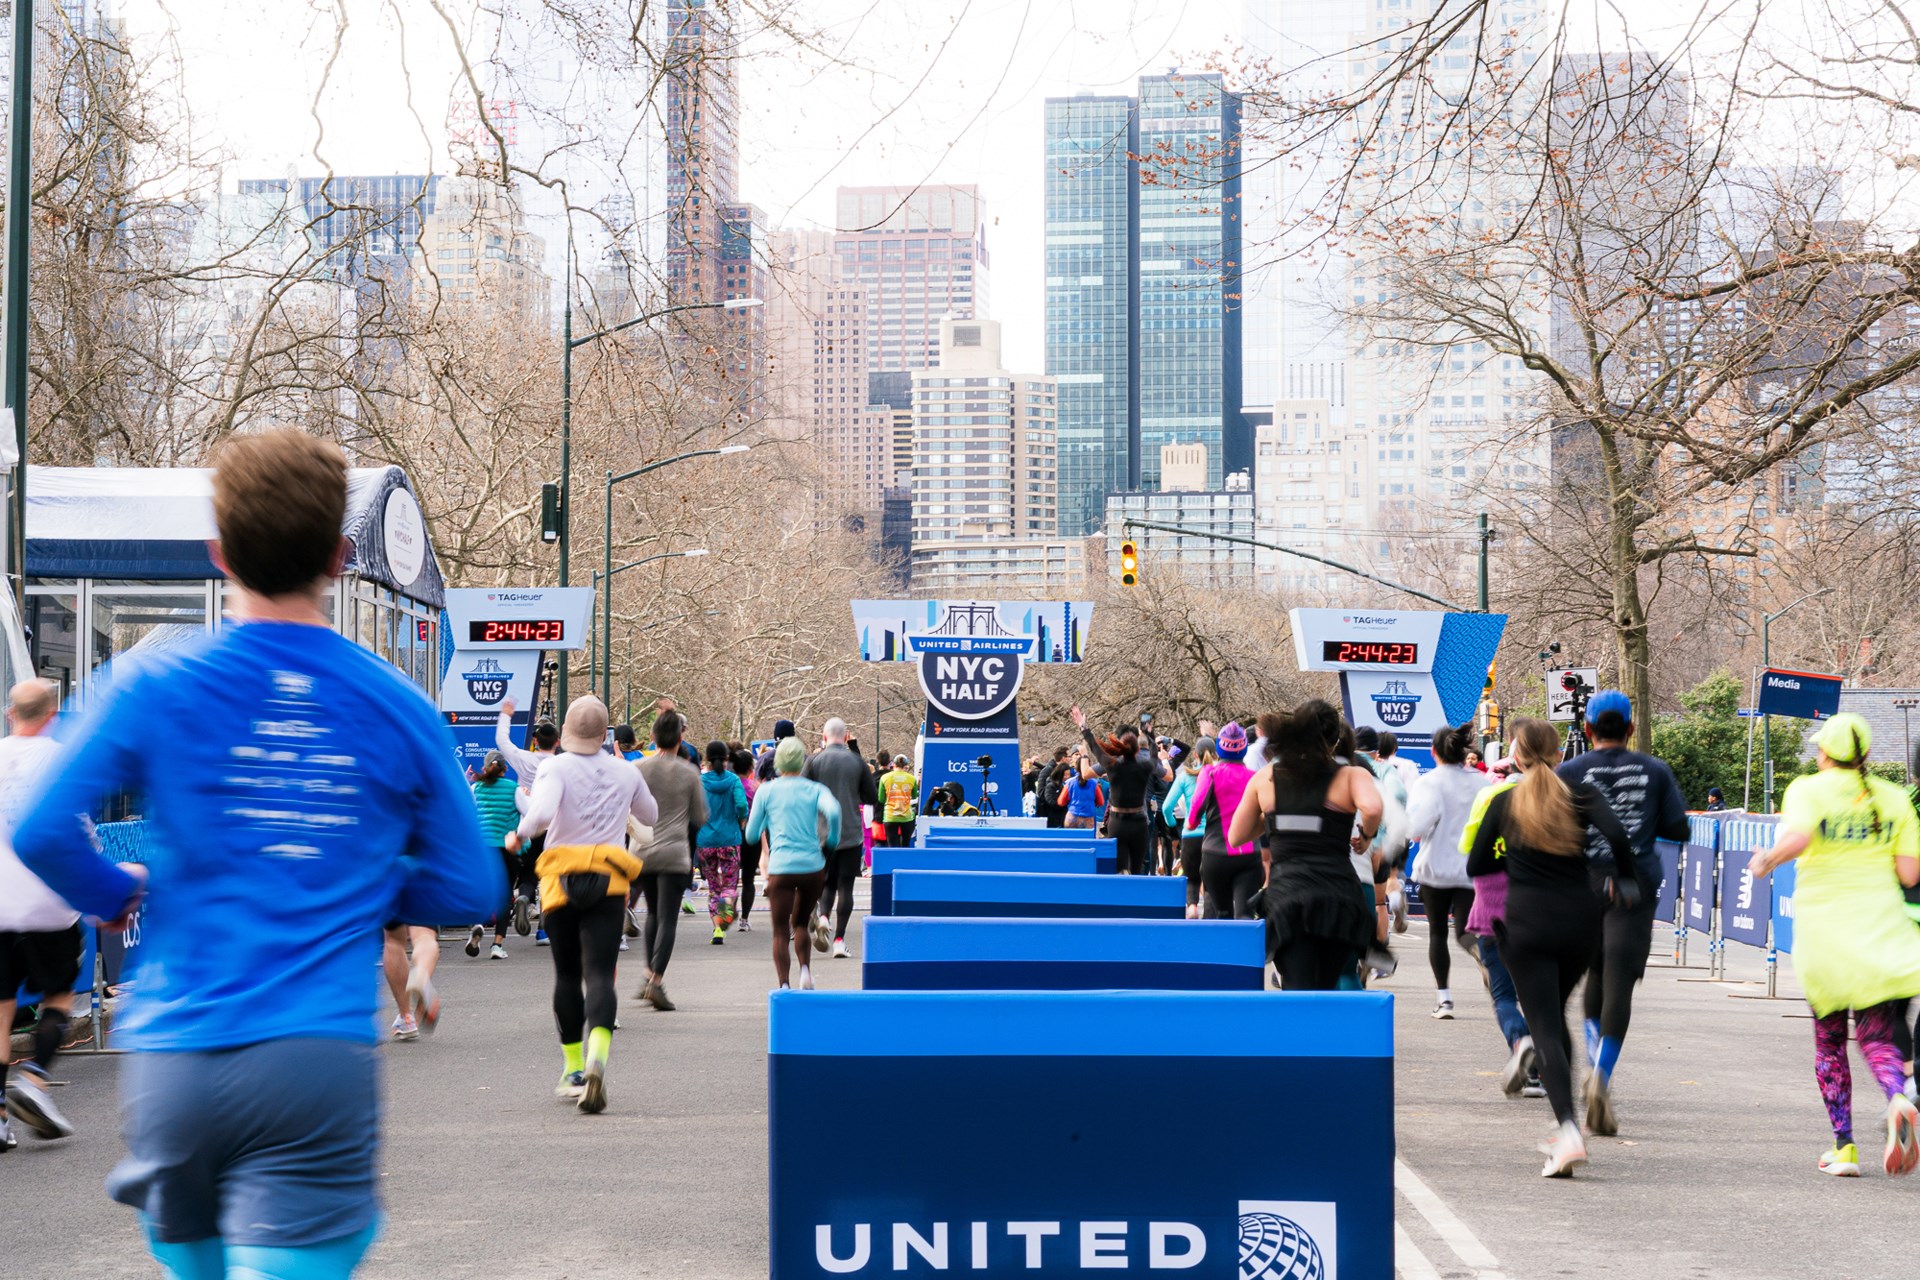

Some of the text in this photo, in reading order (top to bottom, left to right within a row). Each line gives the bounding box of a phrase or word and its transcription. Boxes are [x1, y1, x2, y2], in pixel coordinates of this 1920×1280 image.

[973, 642, 1023, 650] AIRLINES
[937, 656, 1005, 681] NYC
[473, 681, 502, 692] NYC
[1768, 677, 1800, 690] Media
[475, 692, 500, 700] HALF
[941, 683, 999, 700] HALF
[1381, 702, 1410, 713] NYC
[1384, 714, 1408, 722] HALF
[948, 760, 968, 772] tcs
[815, 1221, 1207, 1273] UNITED
